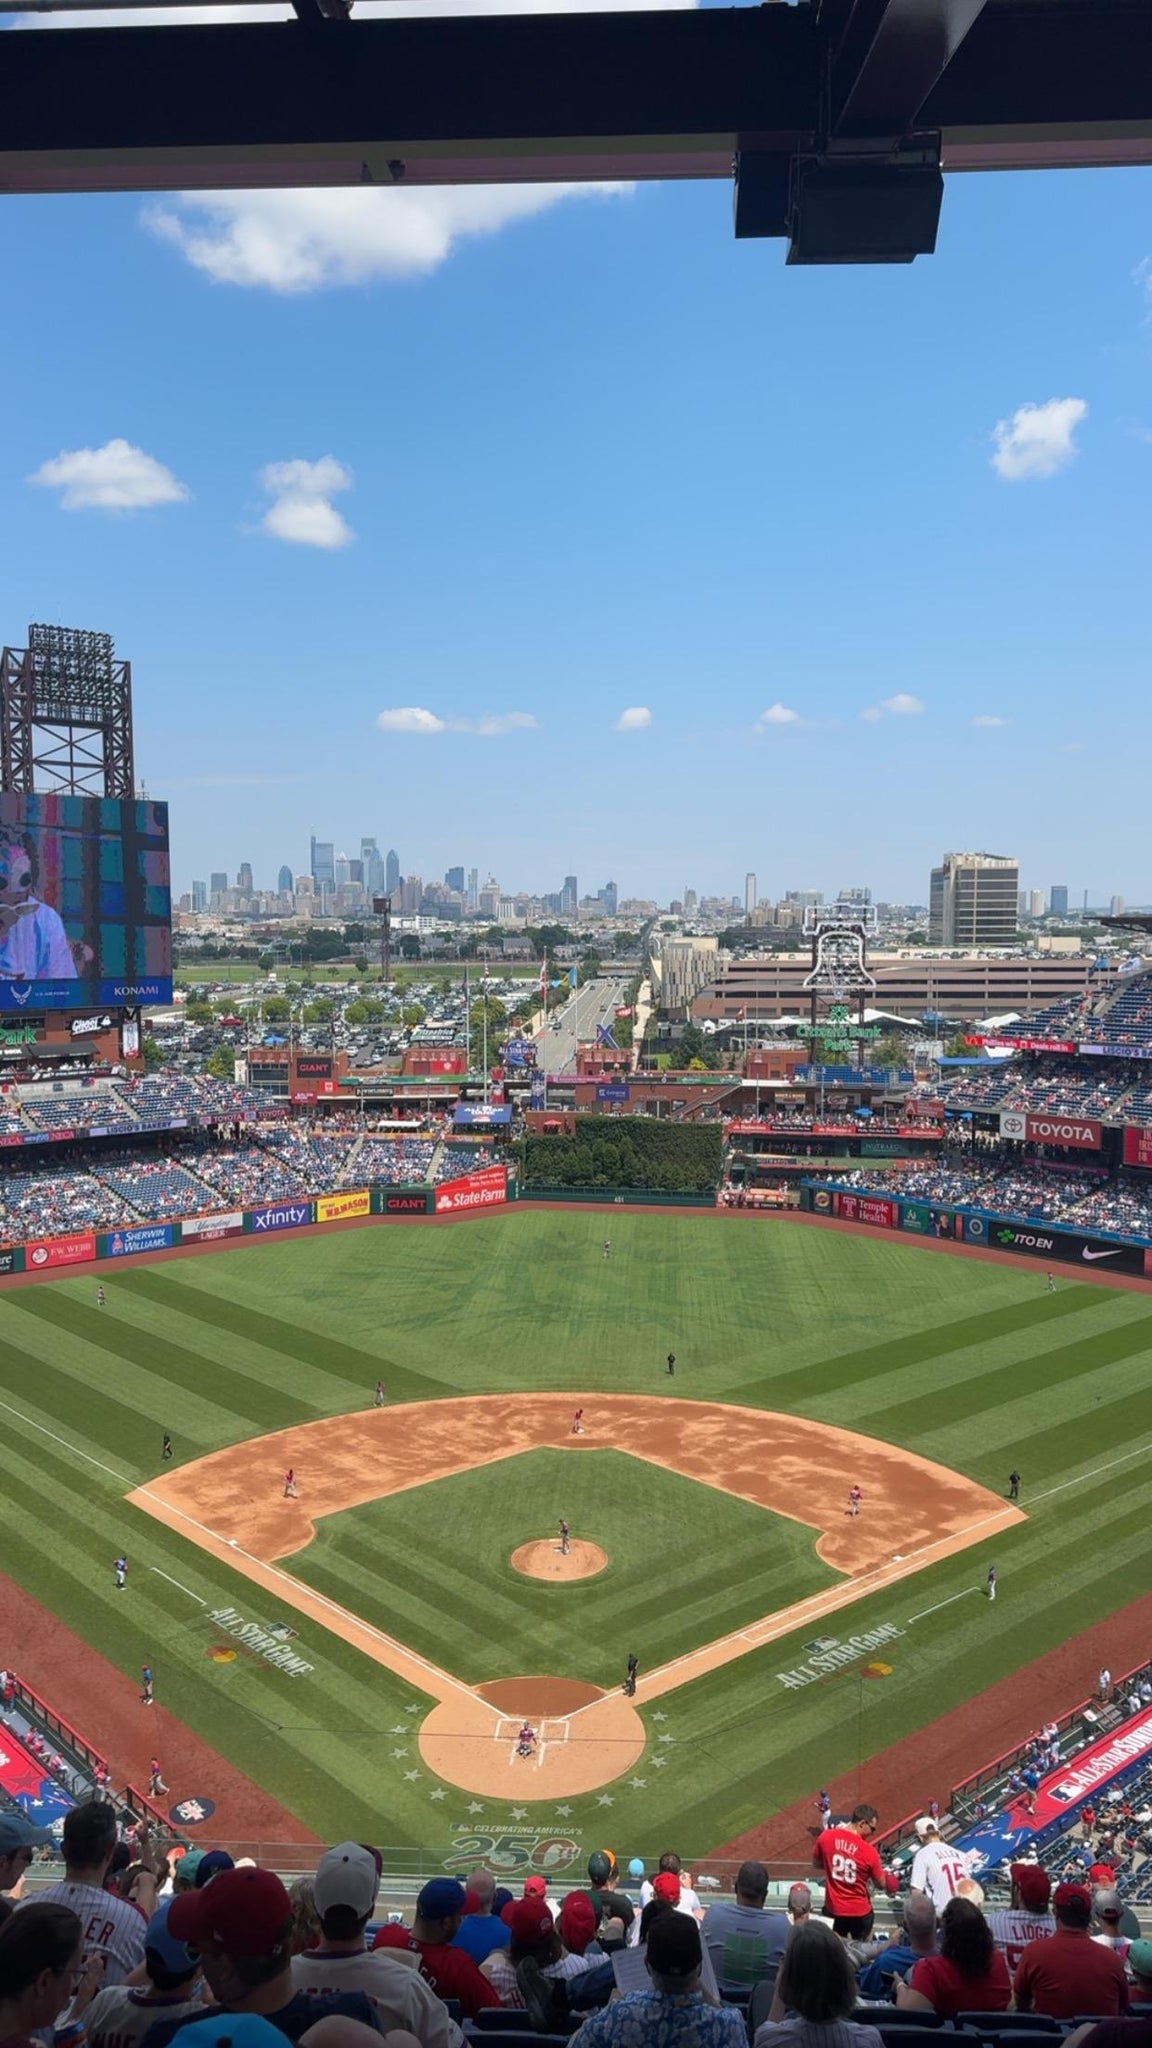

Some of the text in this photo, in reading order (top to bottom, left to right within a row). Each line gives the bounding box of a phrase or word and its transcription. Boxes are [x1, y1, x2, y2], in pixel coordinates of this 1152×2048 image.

[114, 985, 159, 996] KONAMI
[796, 1023, 882, 1038] Citizens Bank
[823, 1038, 853, 1051] Park
[300, 1064, 328, 1072] GIANT
[214, 1113, 242, 1122] TOYOTA
[106, 1120, 172, 1134] LISCIO'S BAKERY
[1030, 1121, 1095, 1142] TOYOTA
[387, 1198, 426, 1210] GIANT
[858, 1199, 889, 1216] Temple
[255, 1207, 306, 1229] xfinity
[858, 1209, 887, 1224] Health
[125, 1228, 166, 1242] SHERWIN
[1014, 1233, 1054, 1250] ITO EN
[205, 1607, 315, 1678] ALL STAR GAME
[775, 1622, 907, 1690] ALL STAR GAME
[474, 1824, 584, 1836] CELEBRATING AMERICA'S
[834, 1839, 859, 1856] UTLEY
[831, 1853, 858, 1885] 26
